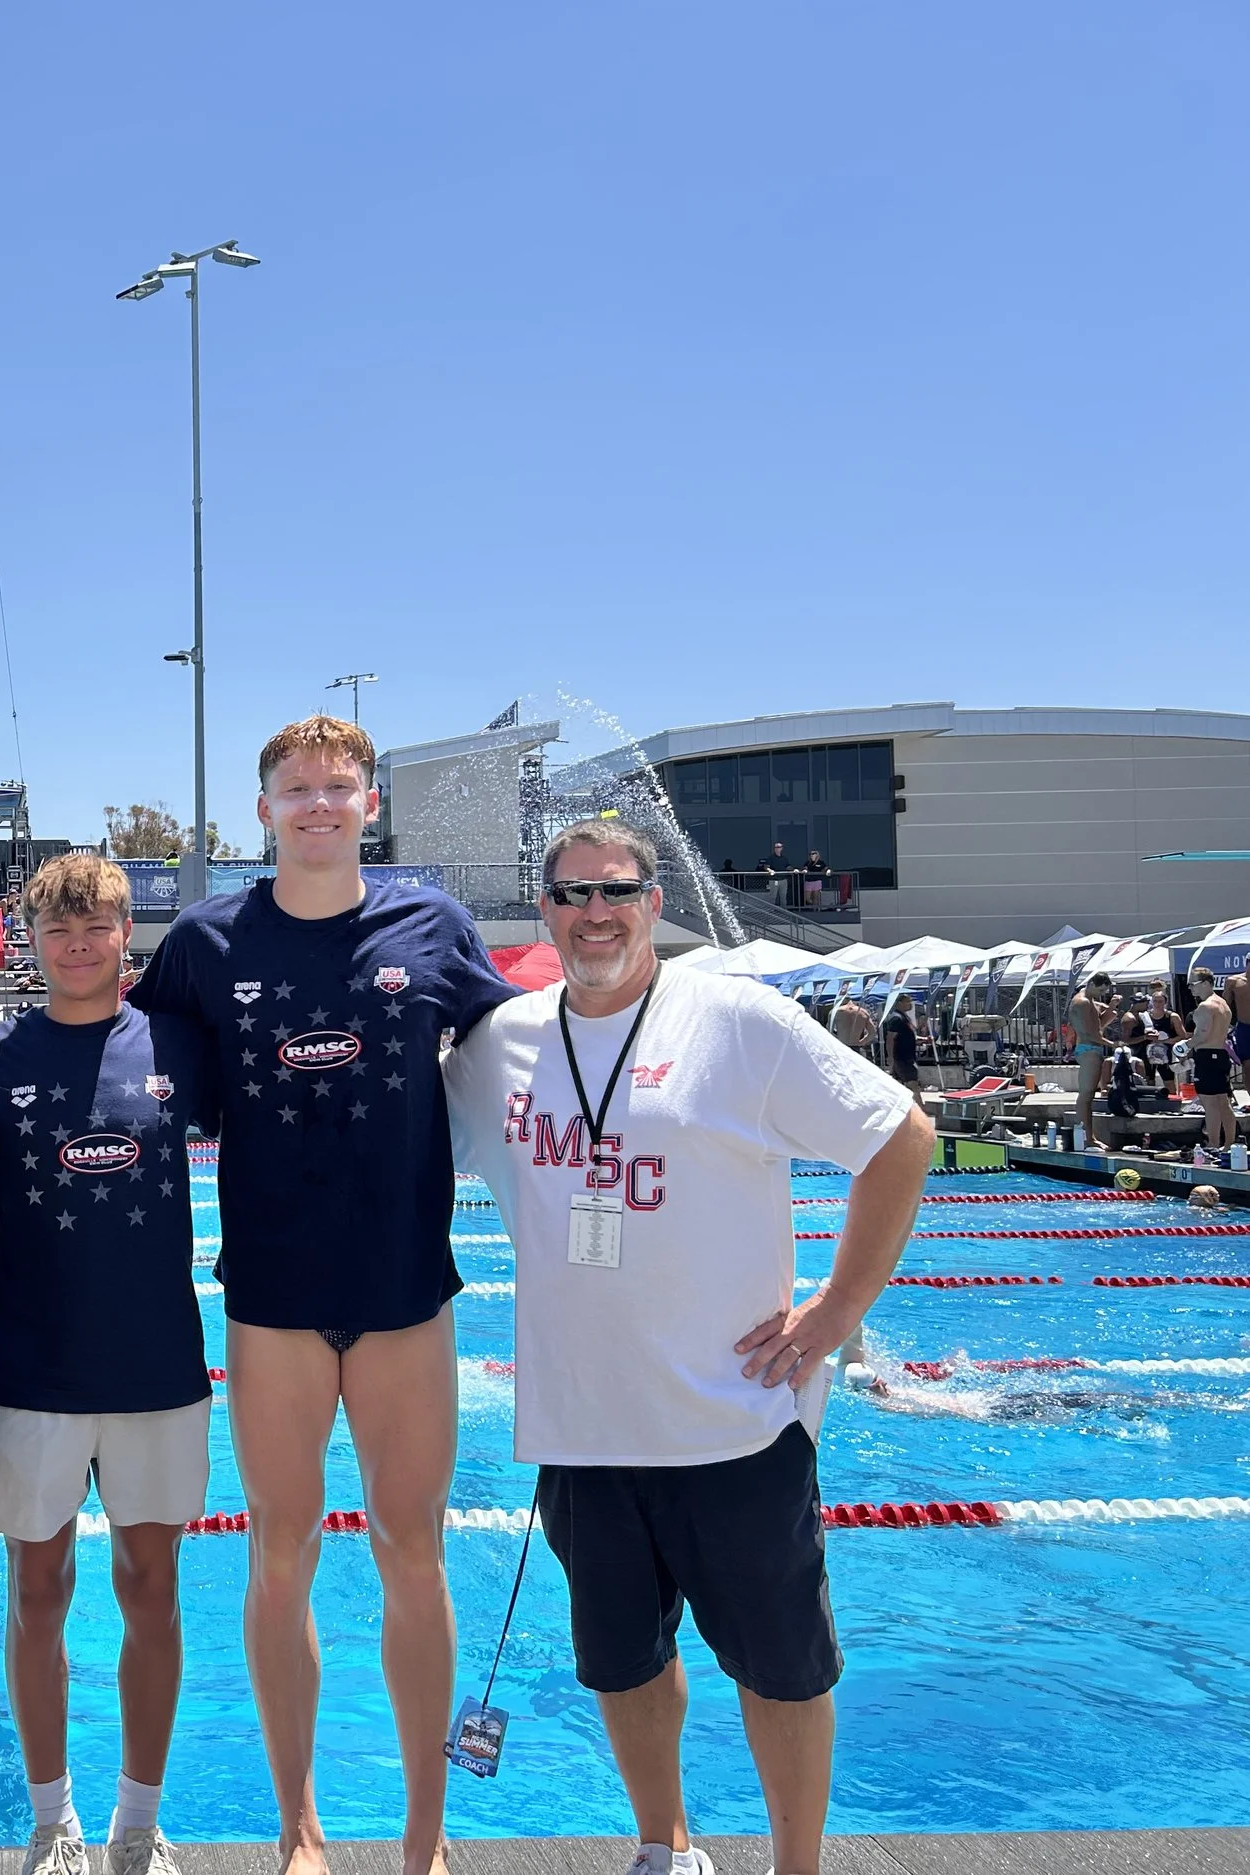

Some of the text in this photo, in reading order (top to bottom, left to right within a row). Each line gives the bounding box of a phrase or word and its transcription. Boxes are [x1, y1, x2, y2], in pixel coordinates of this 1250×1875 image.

[382, 969, 403, 978] USA
[234, 981, 262, 991] arena
[285, 1040, 357, 1058] RMSC
[151, 1077, 168, 1086] USA
[11, 1084, 36, 1096] arena
[66, 1144, 136, 1160] RMSC
[505, 1090, 666, 1212] RMSC
[458, 1736, 498, 1757] SUMMER
[459, 1757, 489, 1775] COACH
